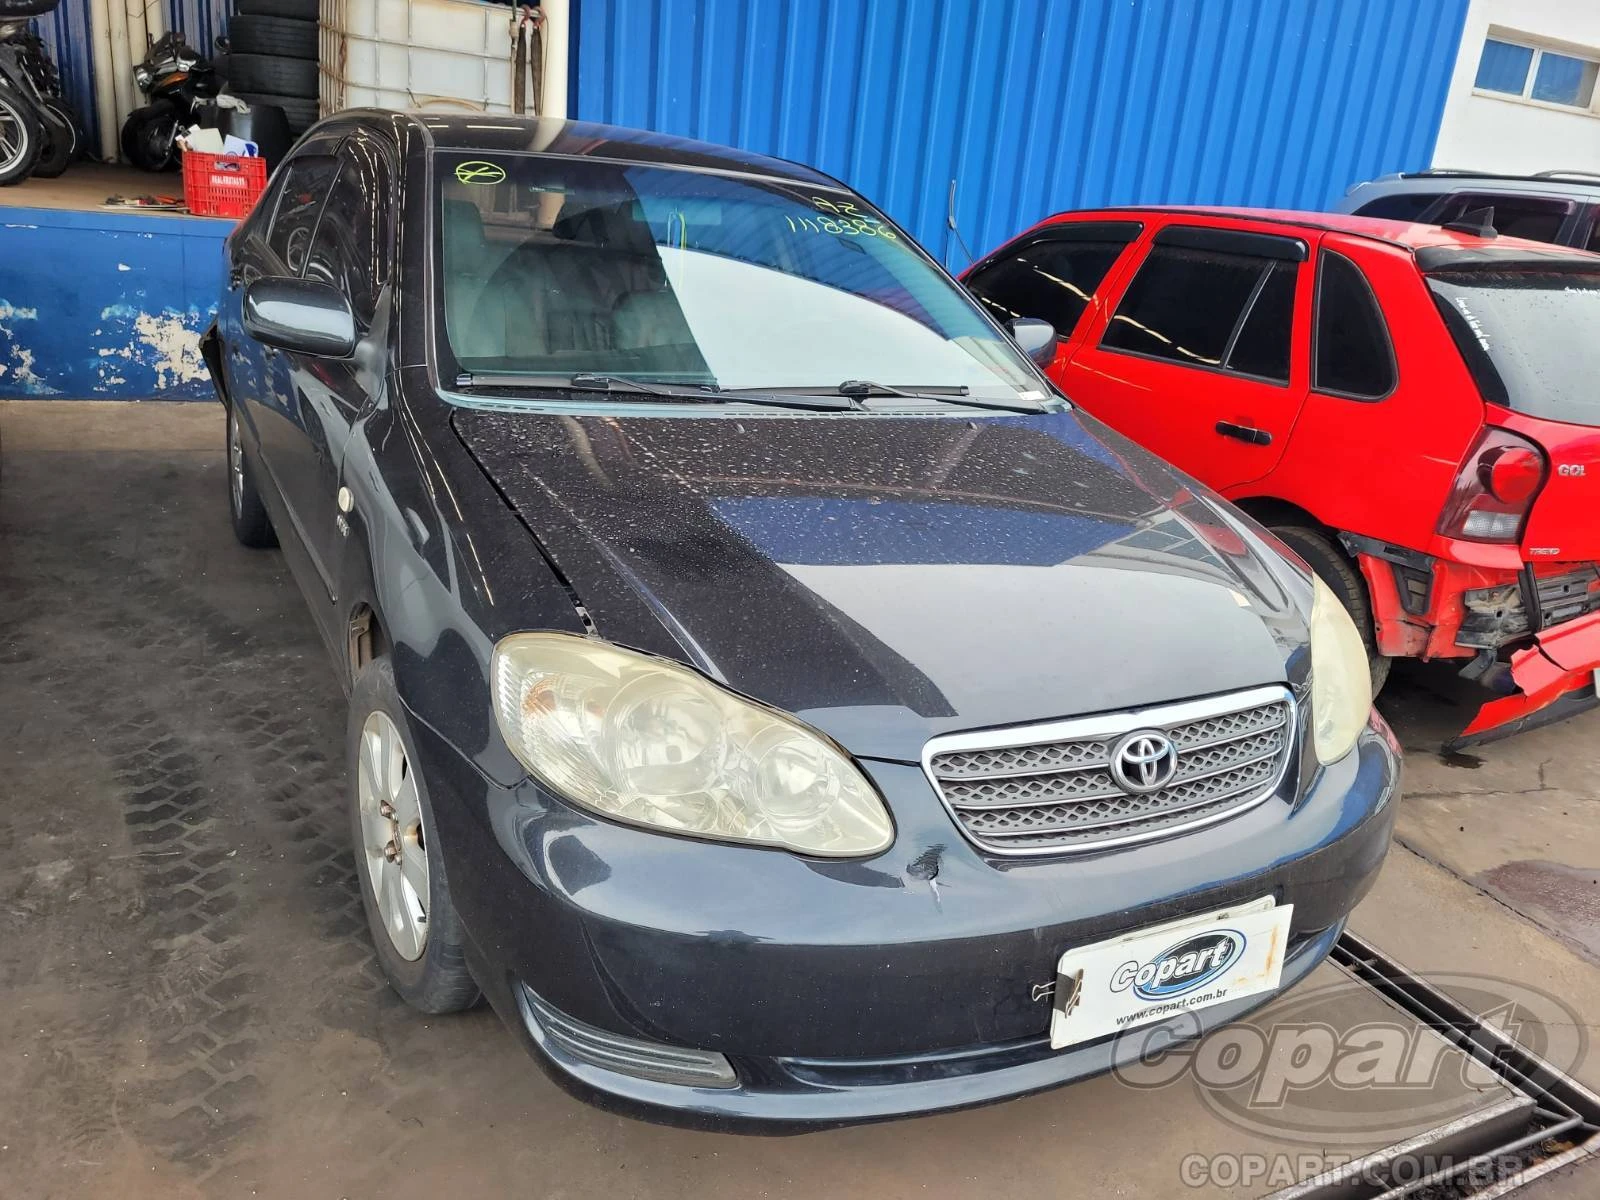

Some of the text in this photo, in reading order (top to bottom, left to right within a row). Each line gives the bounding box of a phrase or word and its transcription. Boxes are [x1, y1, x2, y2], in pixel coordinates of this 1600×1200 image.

[1558, 464, 1586, 476] GOL
[1109, 936, 1233, 993] Copart
[1115, 988, 1228, 1026] www.copart.com.br
